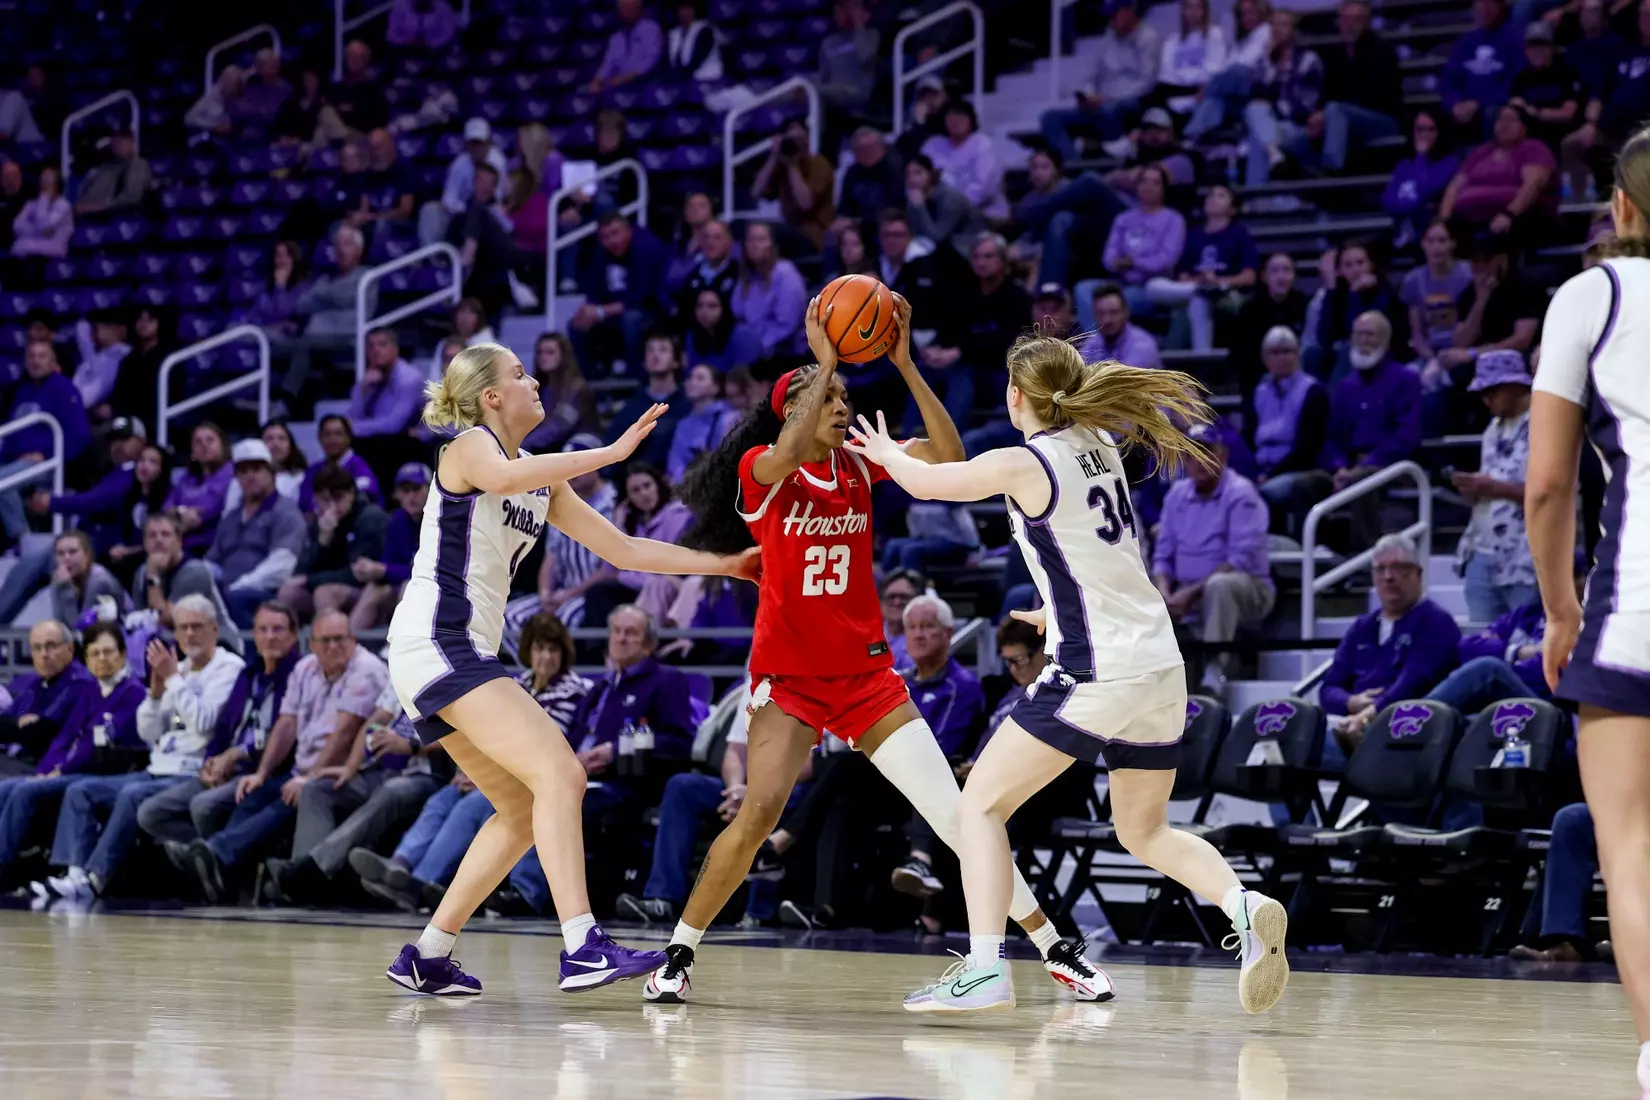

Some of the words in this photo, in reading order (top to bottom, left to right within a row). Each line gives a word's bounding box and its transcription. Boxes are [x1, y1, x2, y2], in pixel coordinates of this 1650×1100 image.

[1075, 449, 1111, 478] HEAL
[783, 501, 867, 537] Houston
[1086, 477, 1137, 545] 34
[802, 544, 851, 596] 23
[1378, 895, 1395, 908] 21
[1484, 897, 1502, 910] 22
